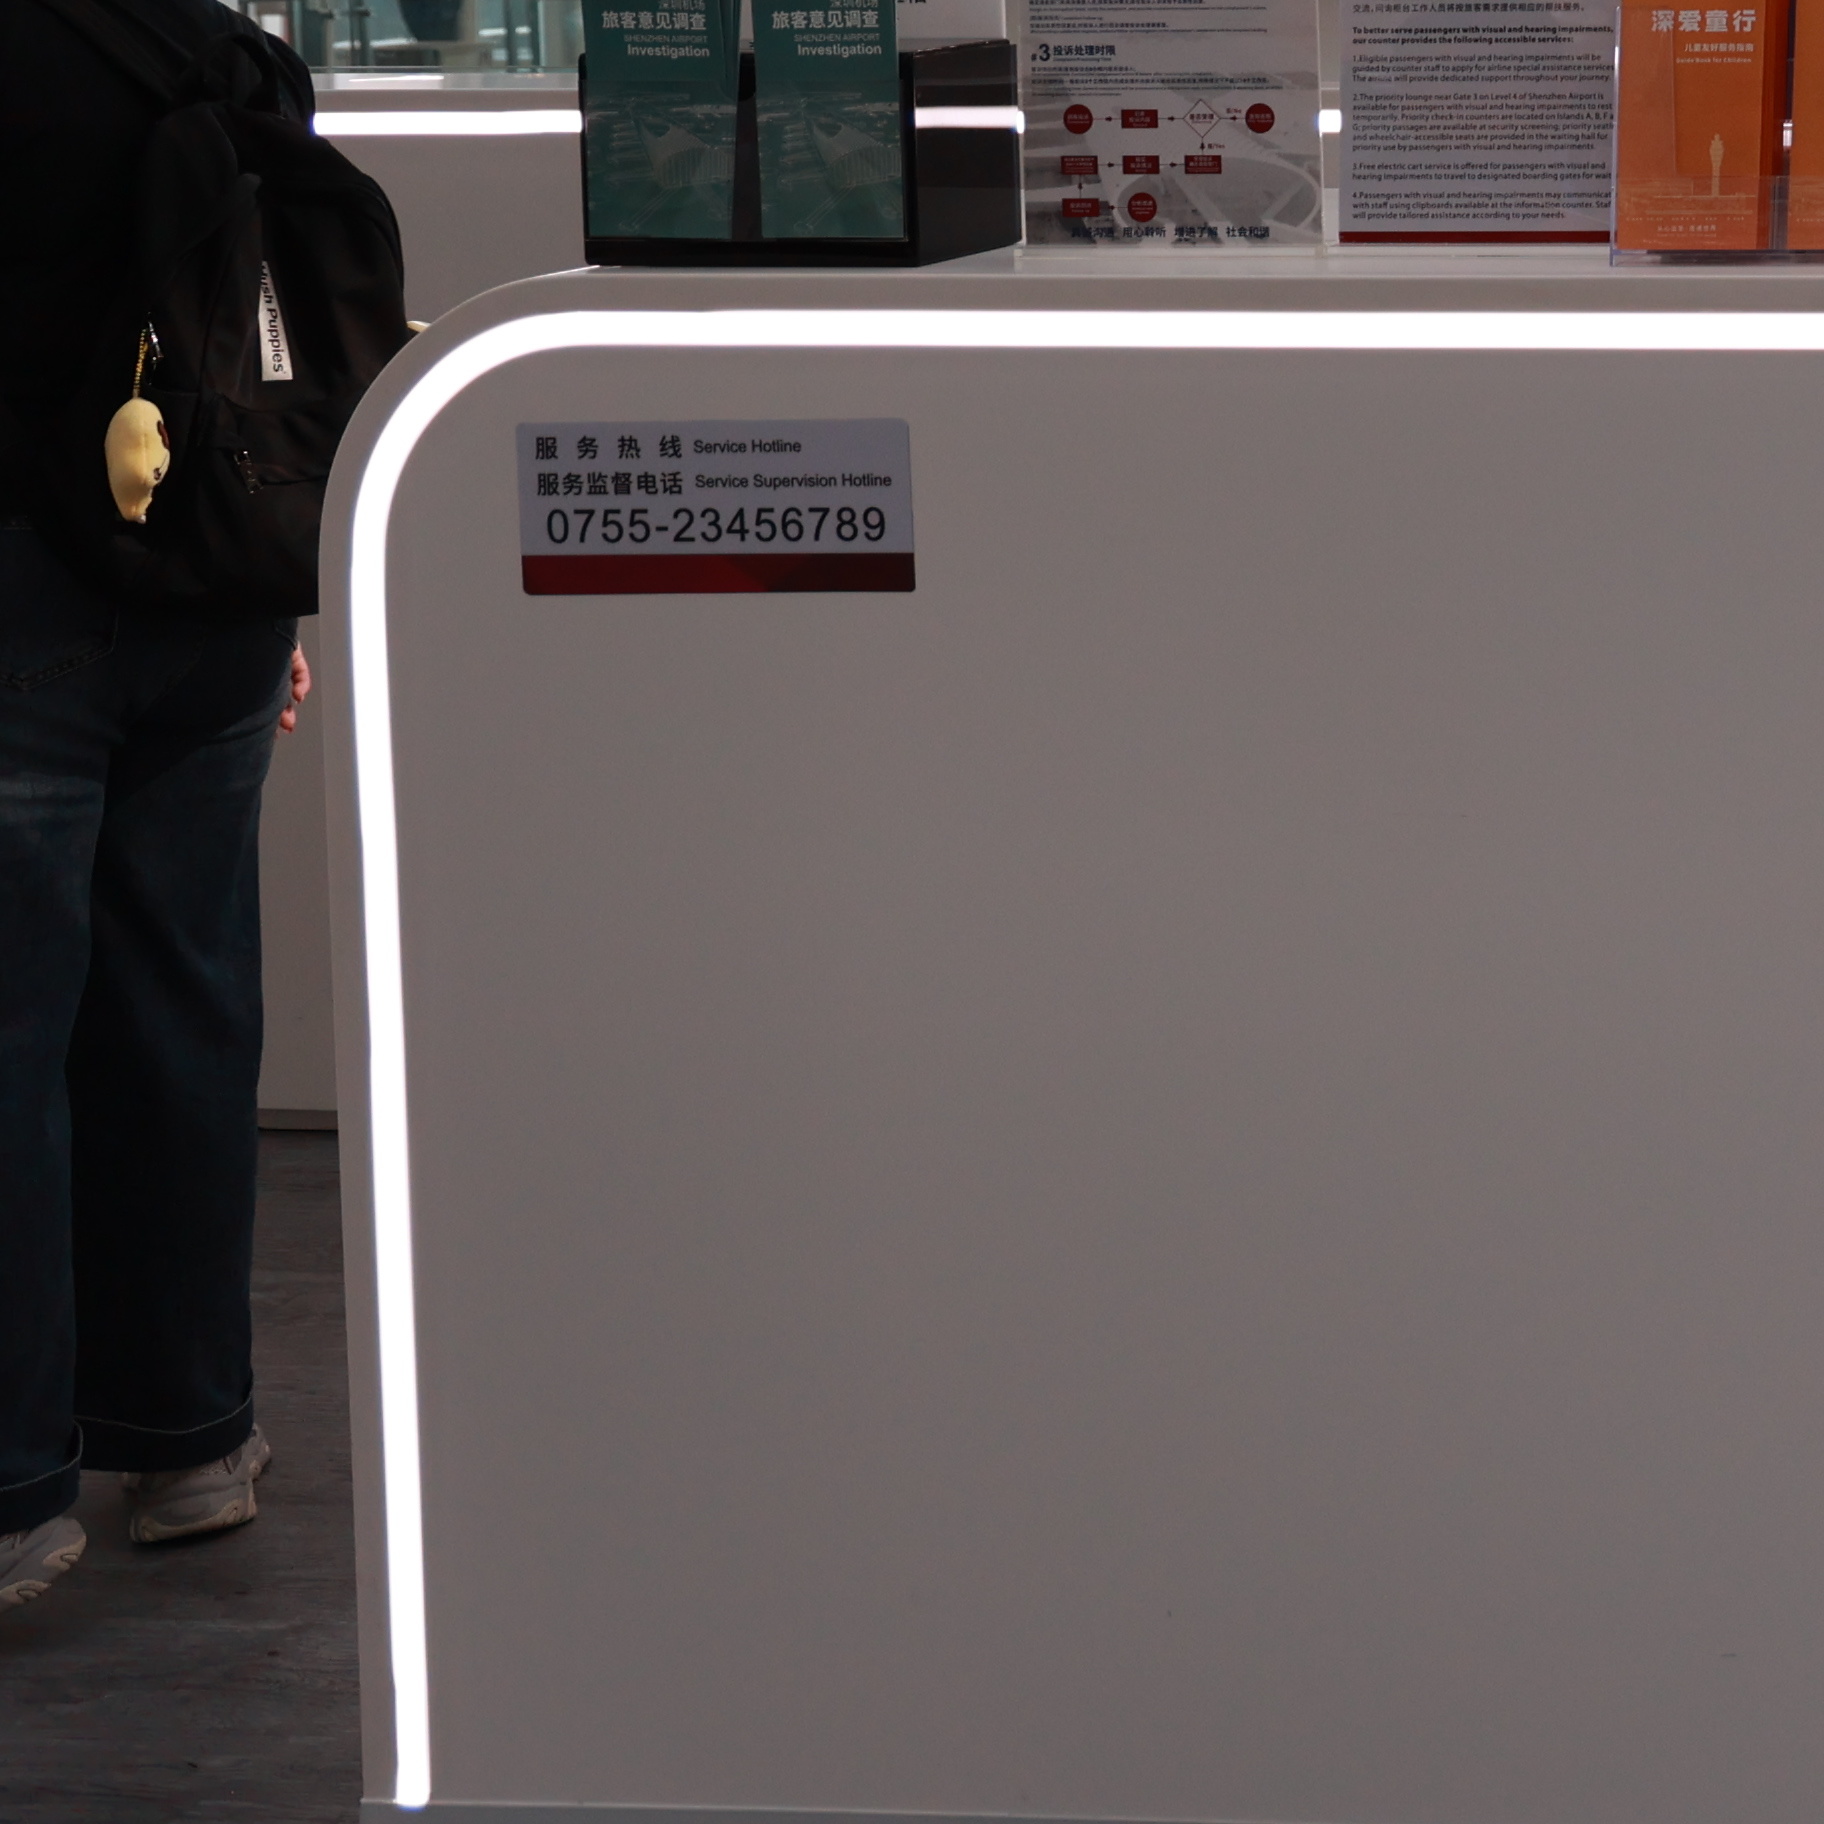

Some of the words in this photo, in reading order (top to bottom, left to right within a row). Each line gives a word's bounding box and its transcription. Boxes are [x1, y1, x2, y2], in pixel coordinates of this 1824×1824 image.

[601, 10, 708, 31] 旅客意见调查
[771, 8, 880, 30] 旅客意见调查
[1651, 9, 1757, 33] 深爱童行
[624, 34, 670, 43] SHENZHEN
[671, 35, 708, 44] AIRPORT
[794, 33, 841, 43] SHENZHEN
[842, 32, 880, 42] AIRPORT
[1353, 26, 1362, 34] To
[1414, 27, 1460, 35] passengers
[1462, 26, 1480, 34] with
[1481, 26, 1506, 34] visual
[1507, 26, 1524, 34] and
[1524, 26, 1558, 37] hearing
[1558, 26, 1614, 35] impairments,
[1438, 36, 1452, 44] the
[1453, 36, 1493, 44] following
[1494, 36, 1536, 44] accessible
[1538, 36, 1573, 44] services:
[1684, 42, 1754, 53] 儿童友好服务指南
[627, 43, 710, 59] Investigation
[797, 42, 882, 57] Investigation
[1053, 44, 1116, 56] 投诉处理时限
[1353, 55, 1388, 63] 1.Eligible
[1389, 55, 1433, 63] passengers
[1477, 54, 1492, 62] and
[1493, 54, 1524, 63] hearing
[1525, 54, 1574, 63] impairments
[1576, 53, 1590, 62] will
[1591, 53, 1601, 62] be
[1122, 227, 1166, 238] 用心聆听
[1226, 226, 1270, 238] 社会和谐
[266, 308, 284, 373] Puppies
[535, 434, 683, 461] 服务热线
[693, 441, 747, 454] Service
[751, 438, 802, 454] Hotline
[537, 471, 683, 497] 服务监督电话
[695, 475, 749, 489] Service
[753, 475, 837, 489] Supervision
[841, 473, 892, 487] Hotline
[546, 506, 886, 544] 0755-23456789
